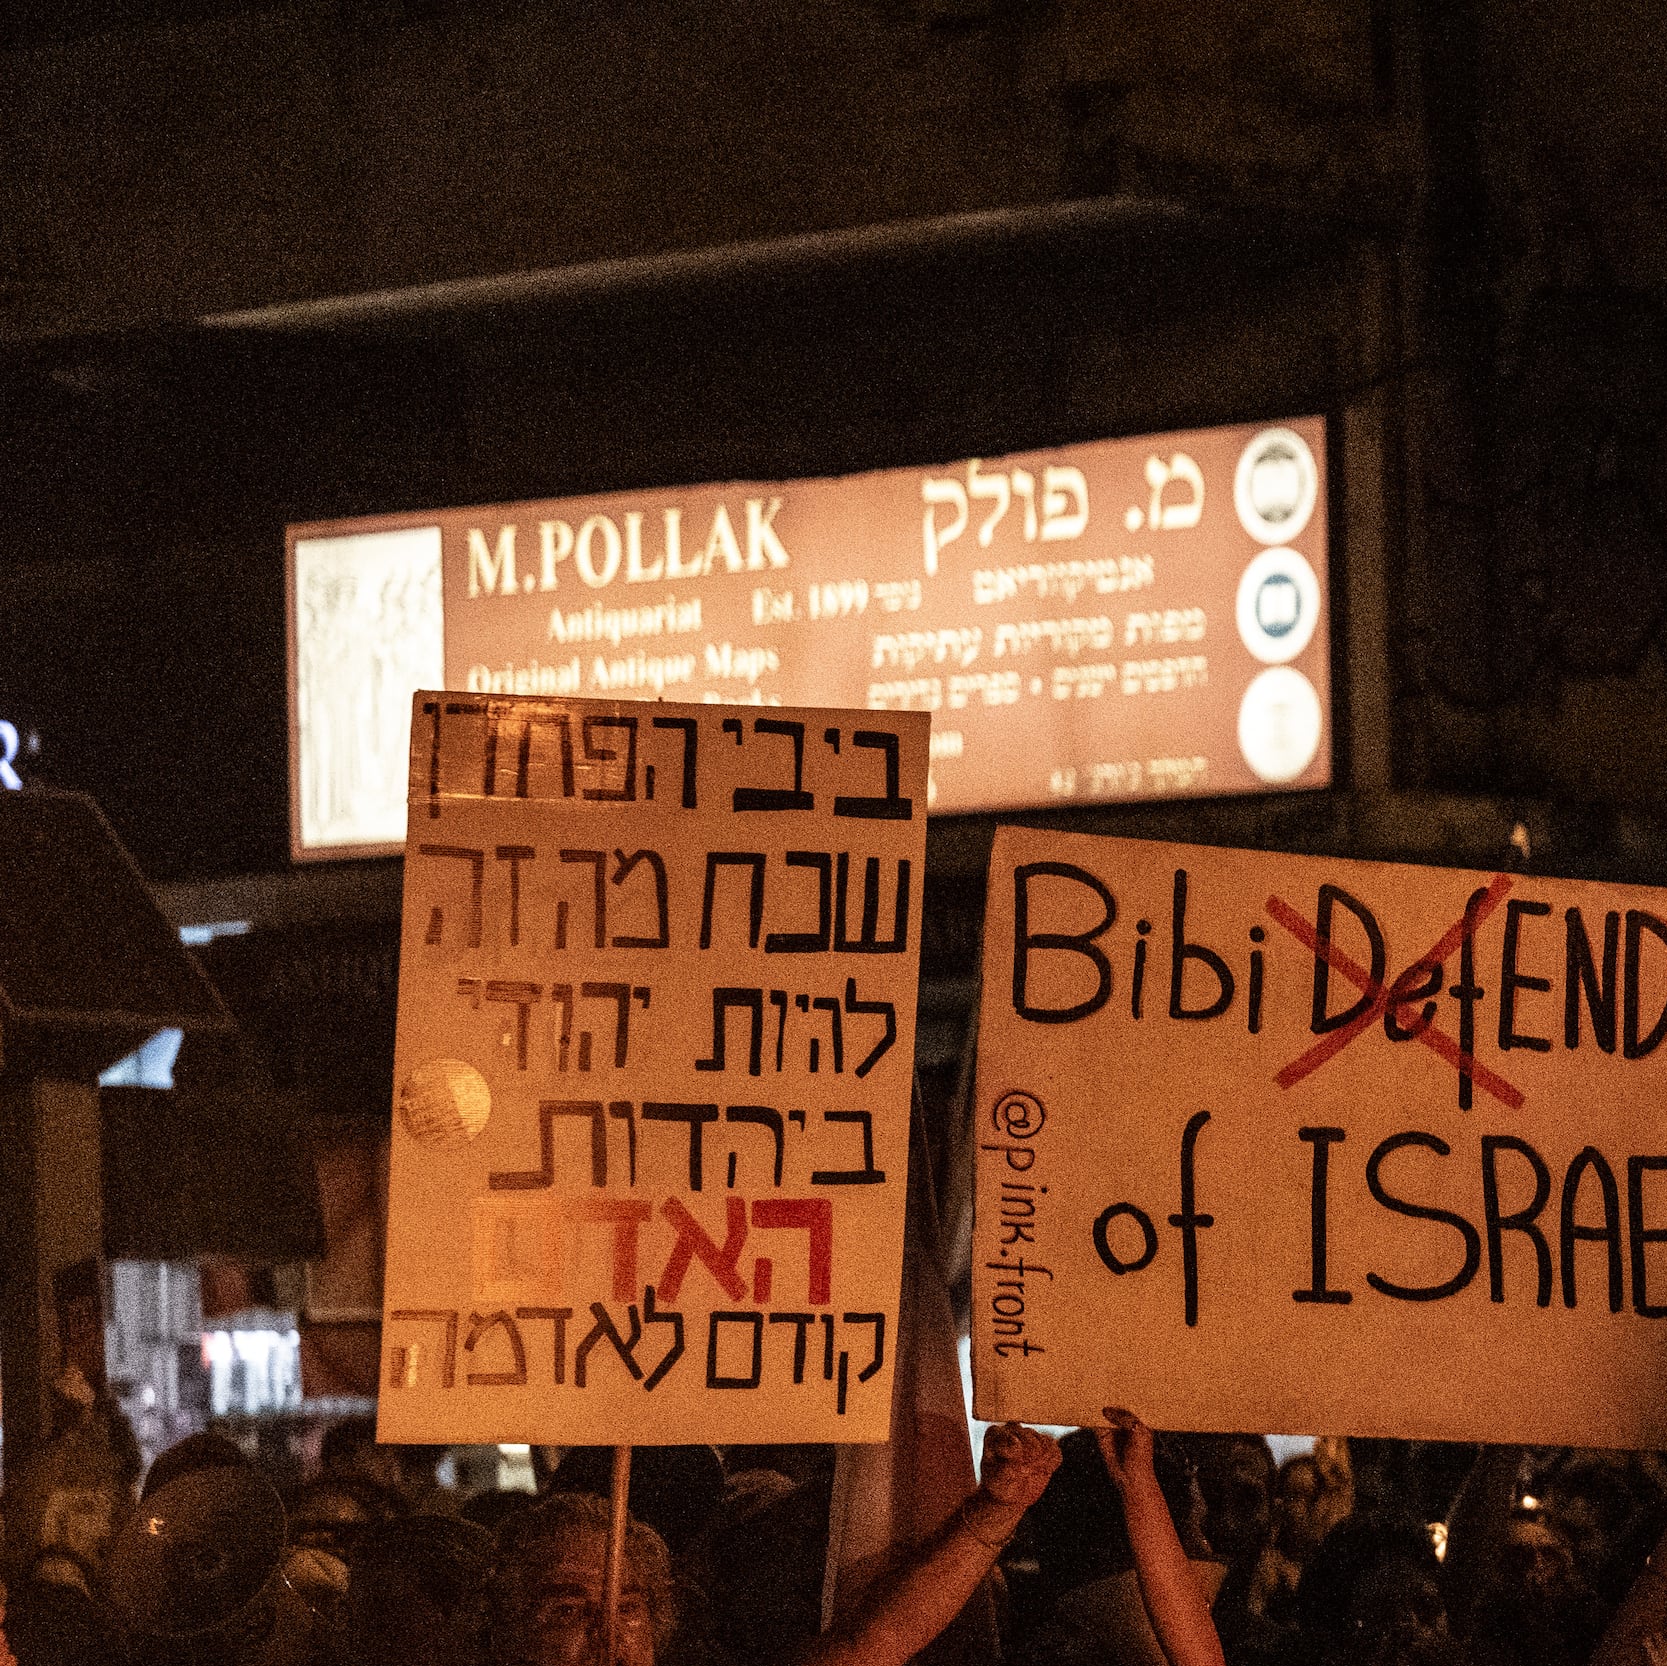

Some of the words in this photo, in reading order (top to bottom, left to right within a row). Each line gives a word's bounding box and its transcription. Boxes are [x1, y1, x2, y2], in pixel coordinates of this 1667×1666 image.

[922, 459, 1090, 577] פולק
[1123, 452, 1206, 532] מ.
[467, 498, 790, 600] M.POLLAK
[548, 594, 703, 645] Antiquariat
[590, 647, 697, 693] Antique
[703, 640, 780, 686] Maps
[721, 717, 913, 820] ביבי
[418, 843, 536, 950] זה
[555, 847, 671, 951] מה
[700, 847, 911, 955] שכח
[1012, 861, 1266, 1036] Bibi
[457, 977, 652, 1073] יהודי
[695, 977, 898, 1079] להיות
[488, 1099, 887, 1192] ביהדות
[980, 1090, 1054, 1358] @pink.front
[1091, 1110, 1216, 1328] of
[388, 1284, 686, 1392] לאדמה
[705, 1310, 887, 1416] קודם
